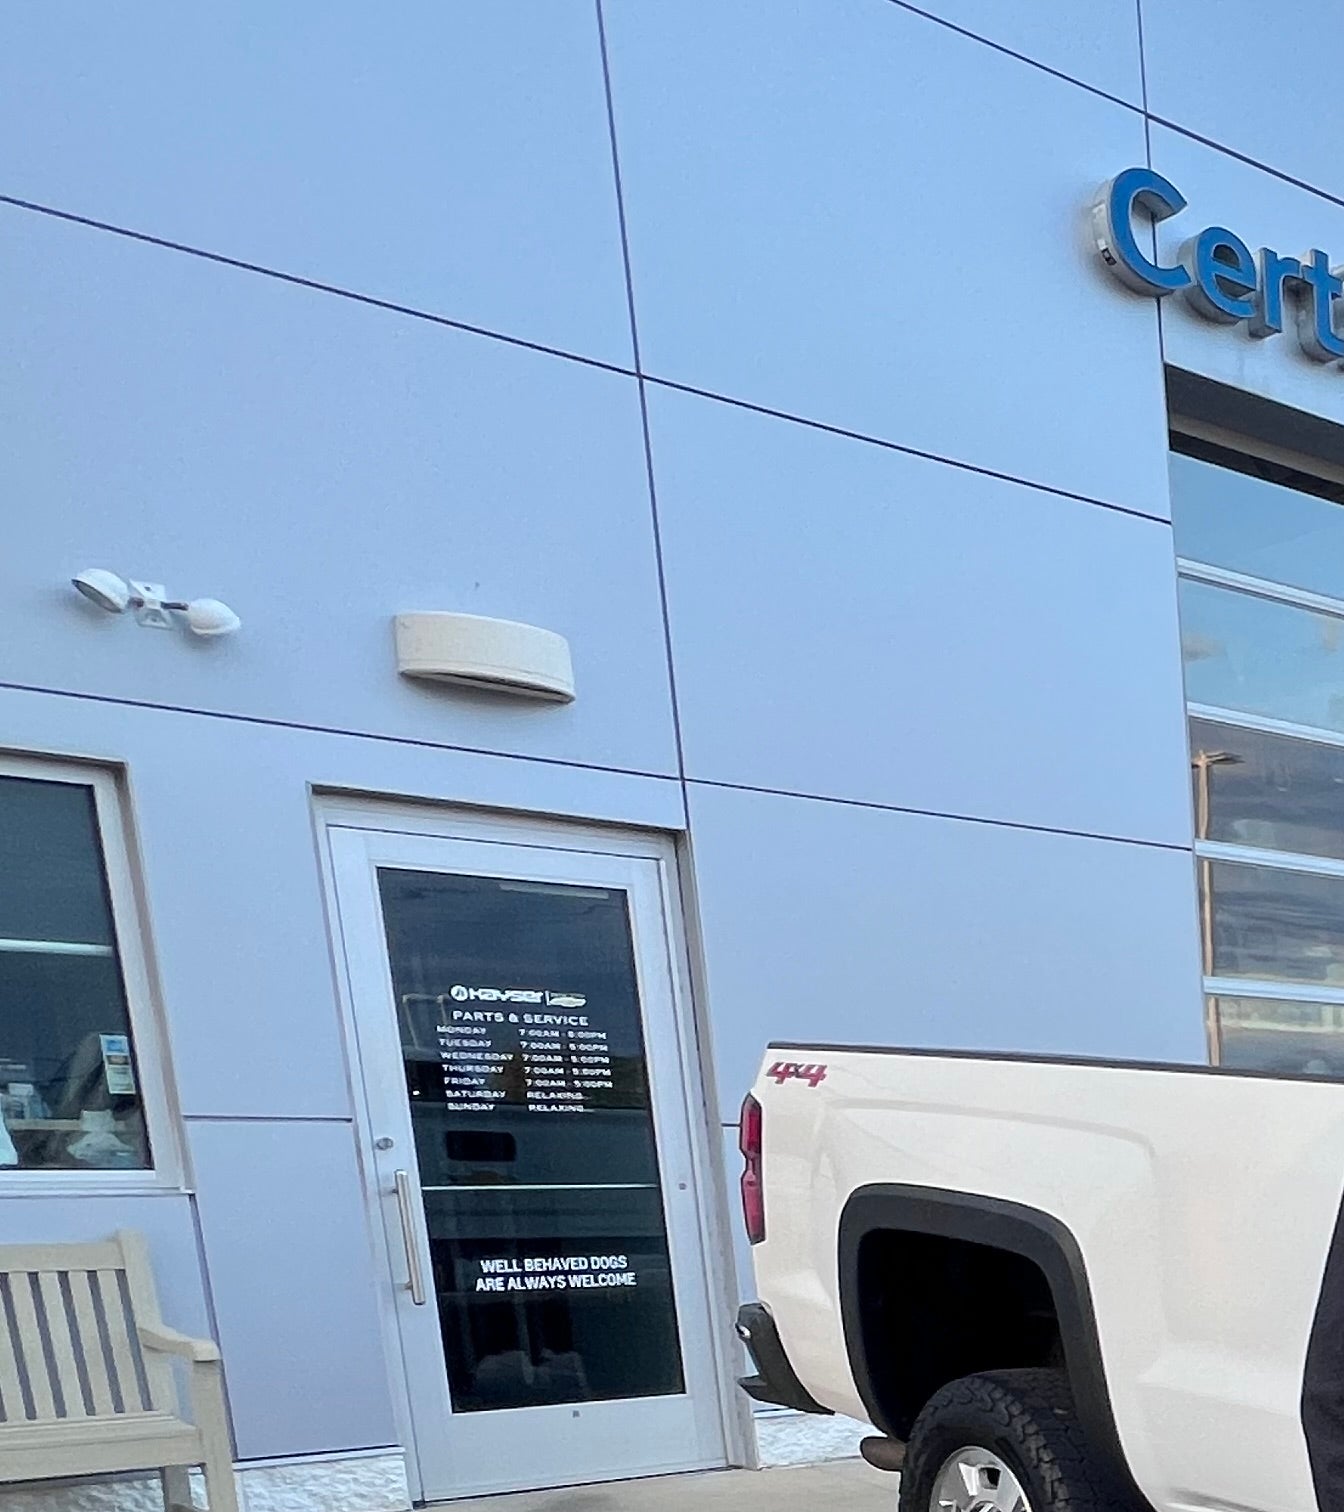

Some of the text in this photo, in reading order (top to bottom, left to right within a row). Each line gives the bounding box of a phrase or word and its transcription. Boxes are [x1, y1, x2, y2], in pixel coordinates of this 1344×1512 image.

[452, 1010, 589, 1026] PARTS & SERVICE
[480, 1255, 628, 1273] WELL BEHAVED DOGS
[475, 1272, 637, 1292] ARE ALWAYS WELCOME
